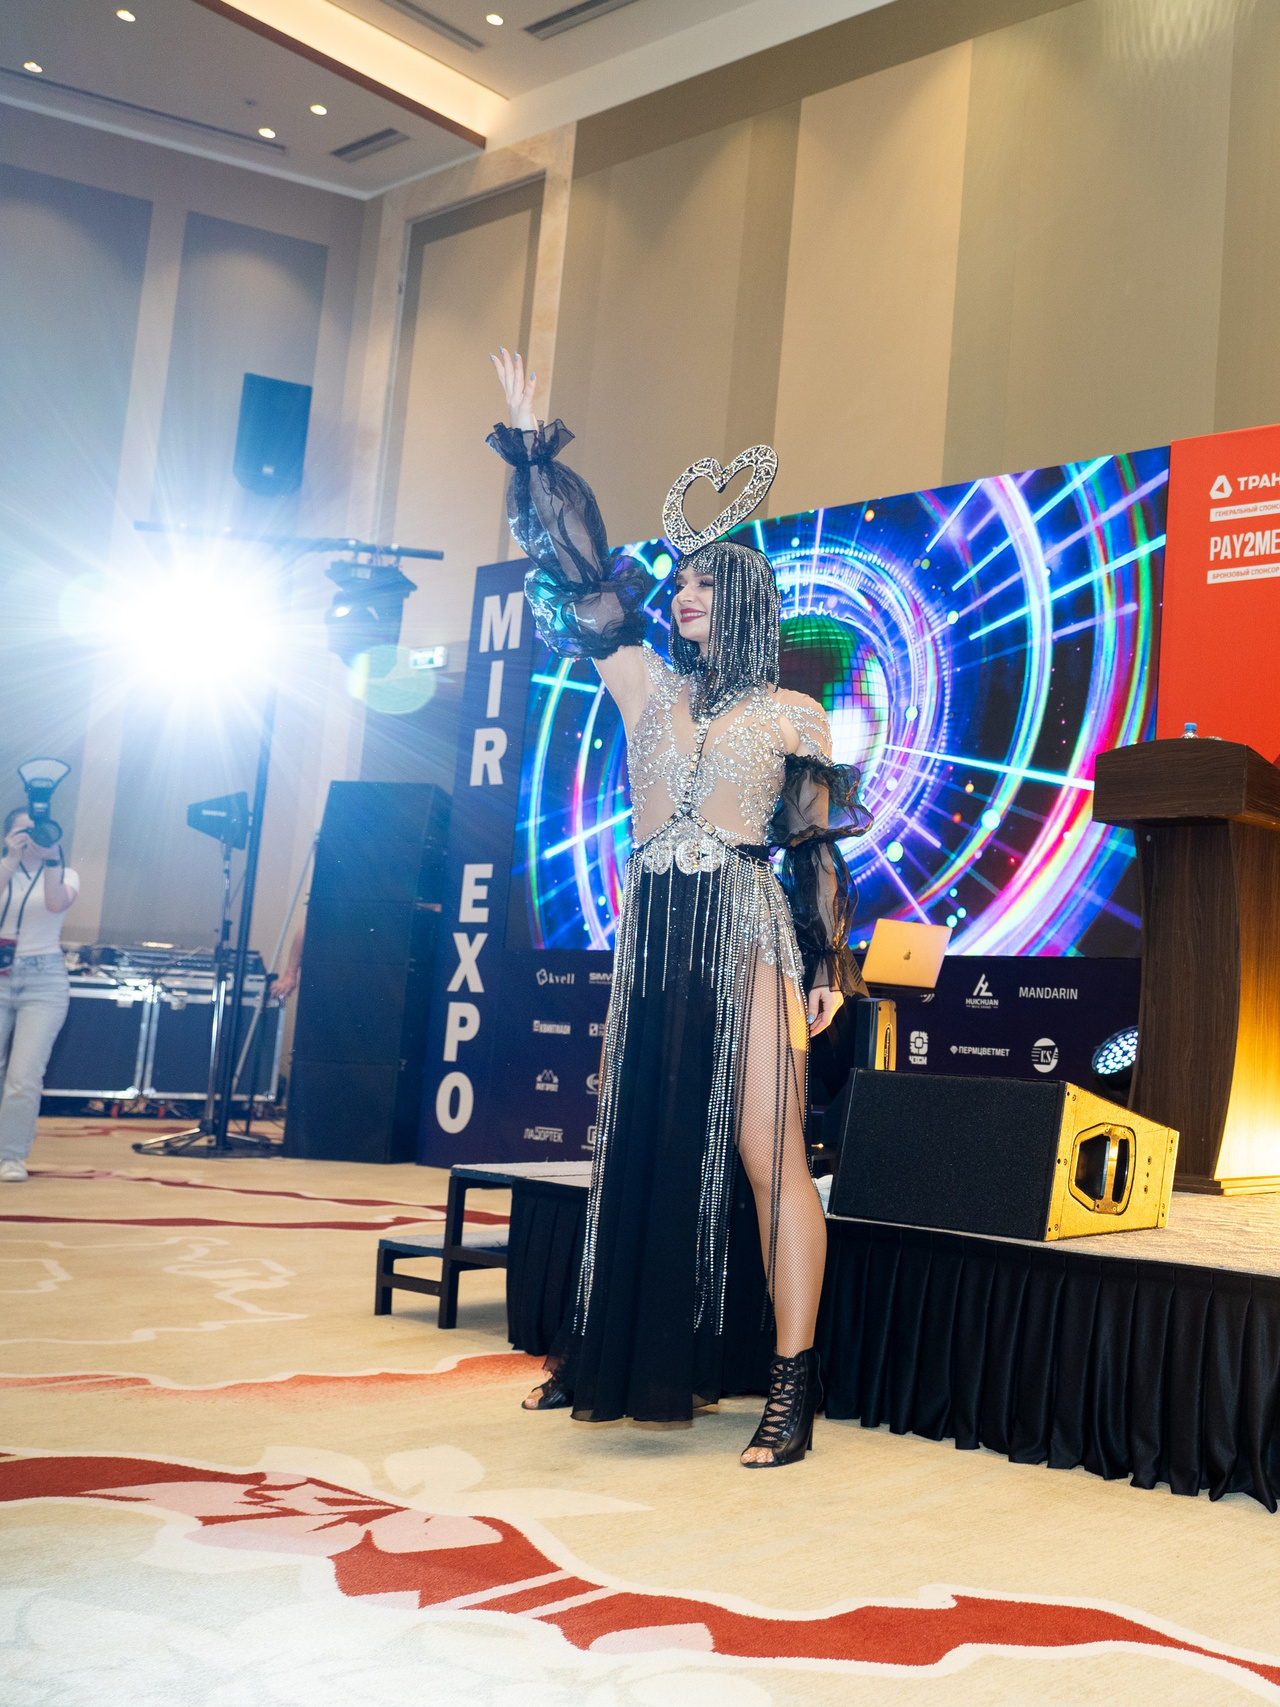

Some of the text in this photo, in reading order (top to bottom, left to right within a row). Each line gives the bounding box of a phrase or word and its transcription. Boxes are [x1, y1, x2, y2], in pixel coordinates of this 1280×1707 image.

[1215, 505, 1258, 518] ГЕНЕРАЛЬНЫЙ
[1212, 566, 1280, 580] БРОНЗОВЫЙ СПОНСОР
[435, 591, 524, 1135] MIR EXPO
[1019, 986, 1078, 1000] MANDARIN
[965, 998, 999, 1006] HUICHUAN
[958, 1046, 1010, 1057] ПЕРМЦВЕТМЕТ
